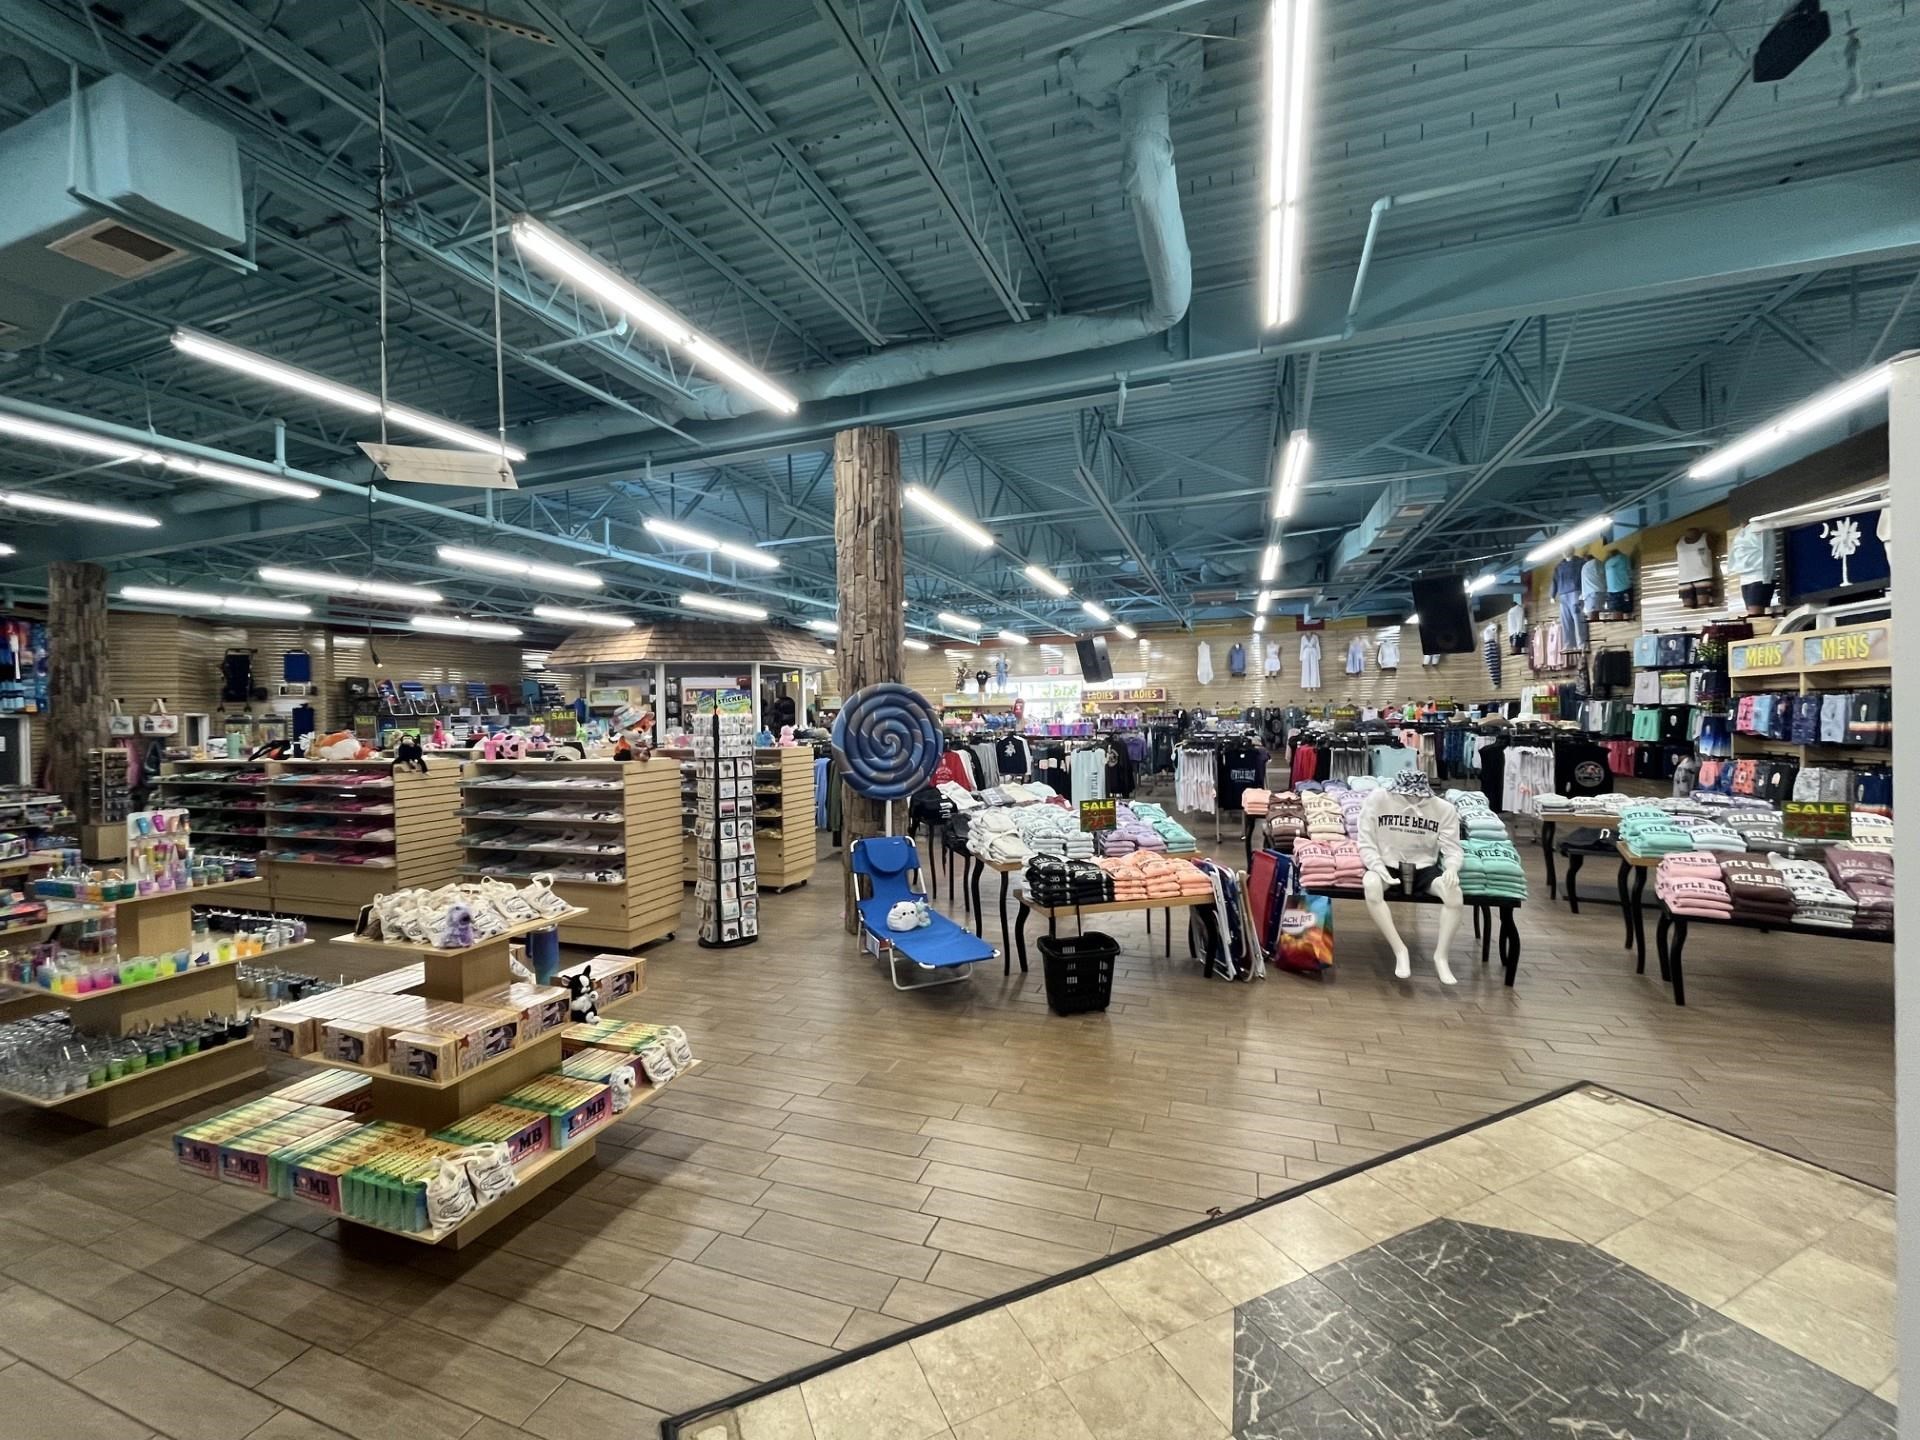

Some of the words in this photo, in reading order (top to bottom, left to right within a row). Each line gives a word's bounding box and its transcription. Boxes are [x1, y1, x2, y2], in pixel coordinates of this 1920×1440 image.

[1746, 645, 1783, 667] MENS
[1822, 633, 1870, 661] MENS
[1129, 688, 1157, 699] LADIES
[552, 711, 576, 720] SALE
[1082, 801, 1114, 811] SALE
[1786, 803, 1846, 814] SALE
[1378, 815, 1410, 828] MYRTLE
[1412, 816, 1439, 833] BEACH
[568, 1115, 575, 1132] I
[586, 1097, 605, 1120] MB
[519, 1127, 542, 1153] MB
[192, 1145, 211, 1163] MB
[239, 1156, 260, 1175] MB
[309, 1176, 331, 1196] MB
